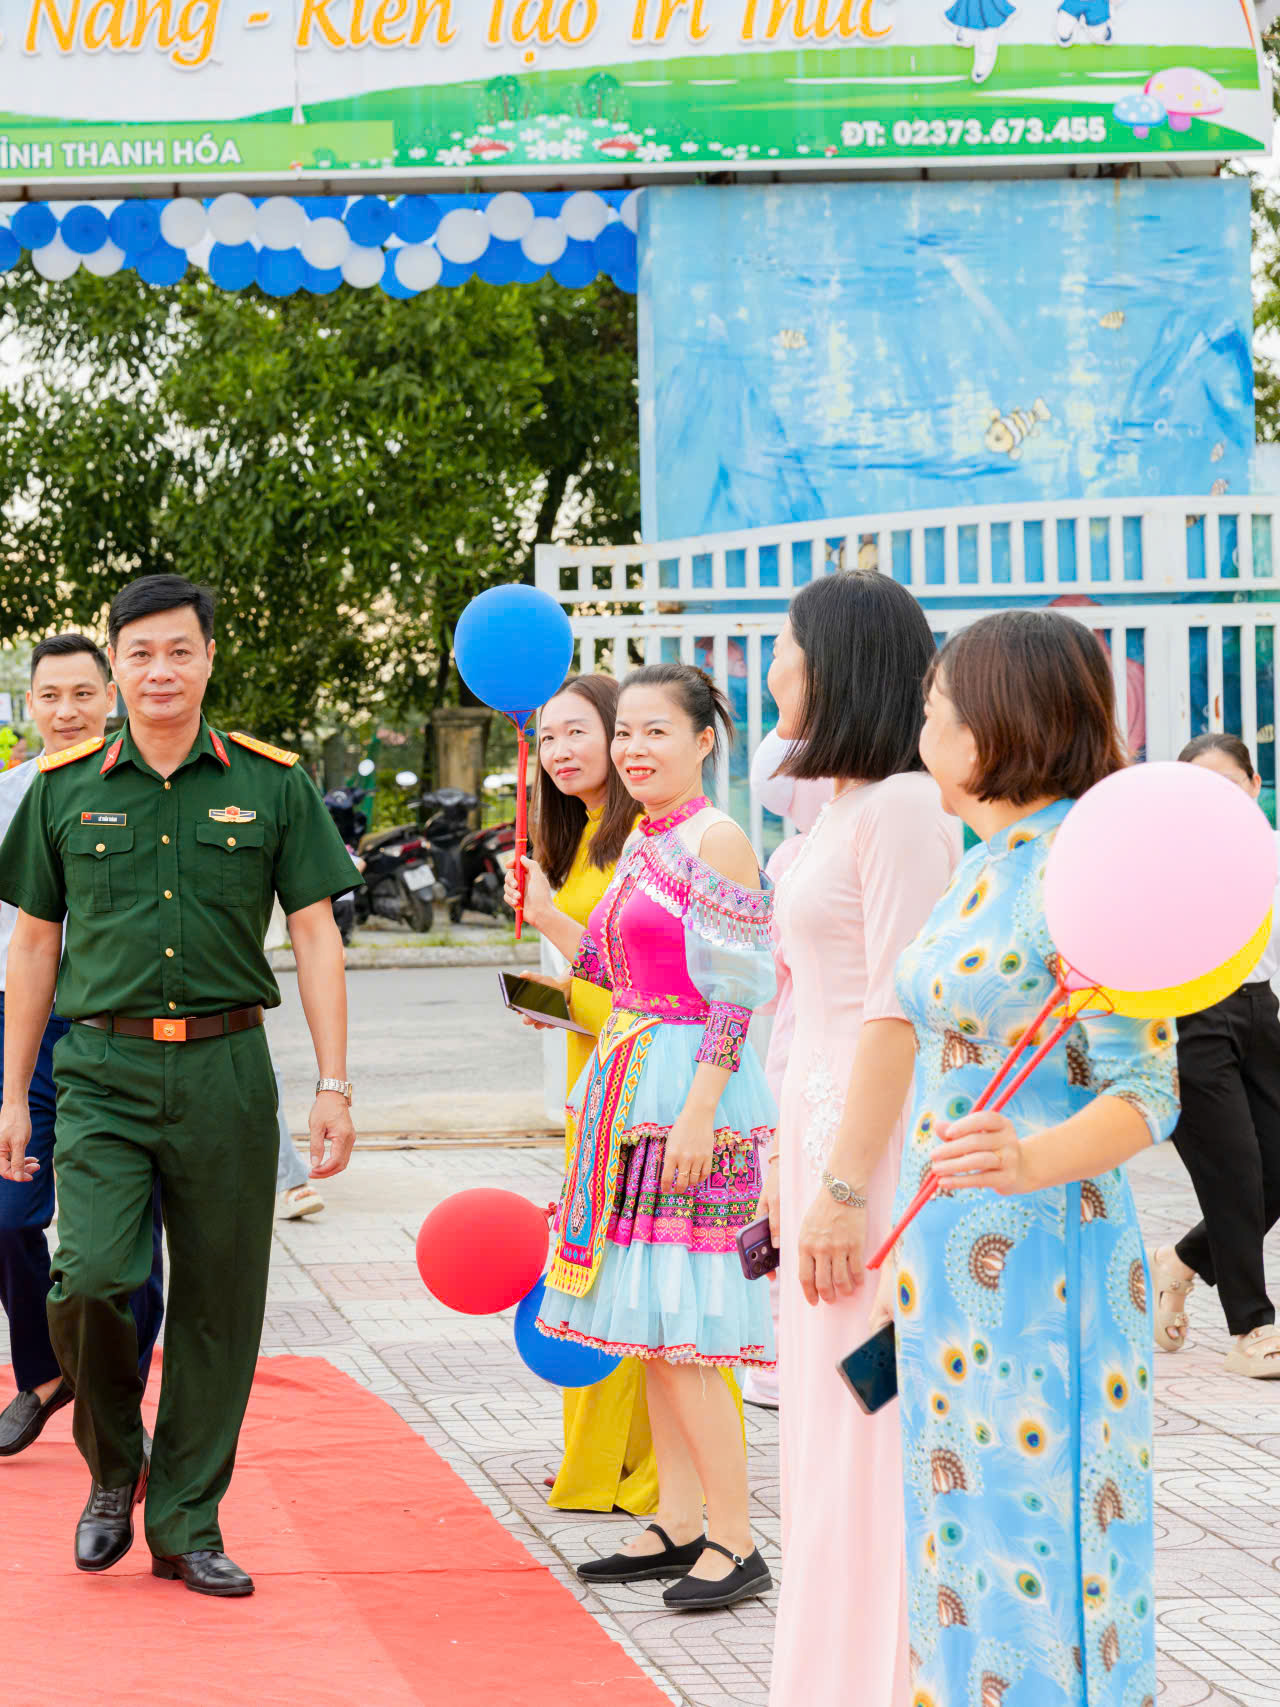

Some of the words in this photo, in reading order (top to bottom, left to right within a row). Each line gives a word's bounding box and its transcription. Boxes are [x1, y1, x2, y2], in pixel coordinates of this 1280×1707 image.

[840, 120, 887, 147] ĐT:
[893, 116, 1107, 146] 02373.673.455
[60, 139, 166, 168] THANH
[172, 133, 242, 166] HÓA
